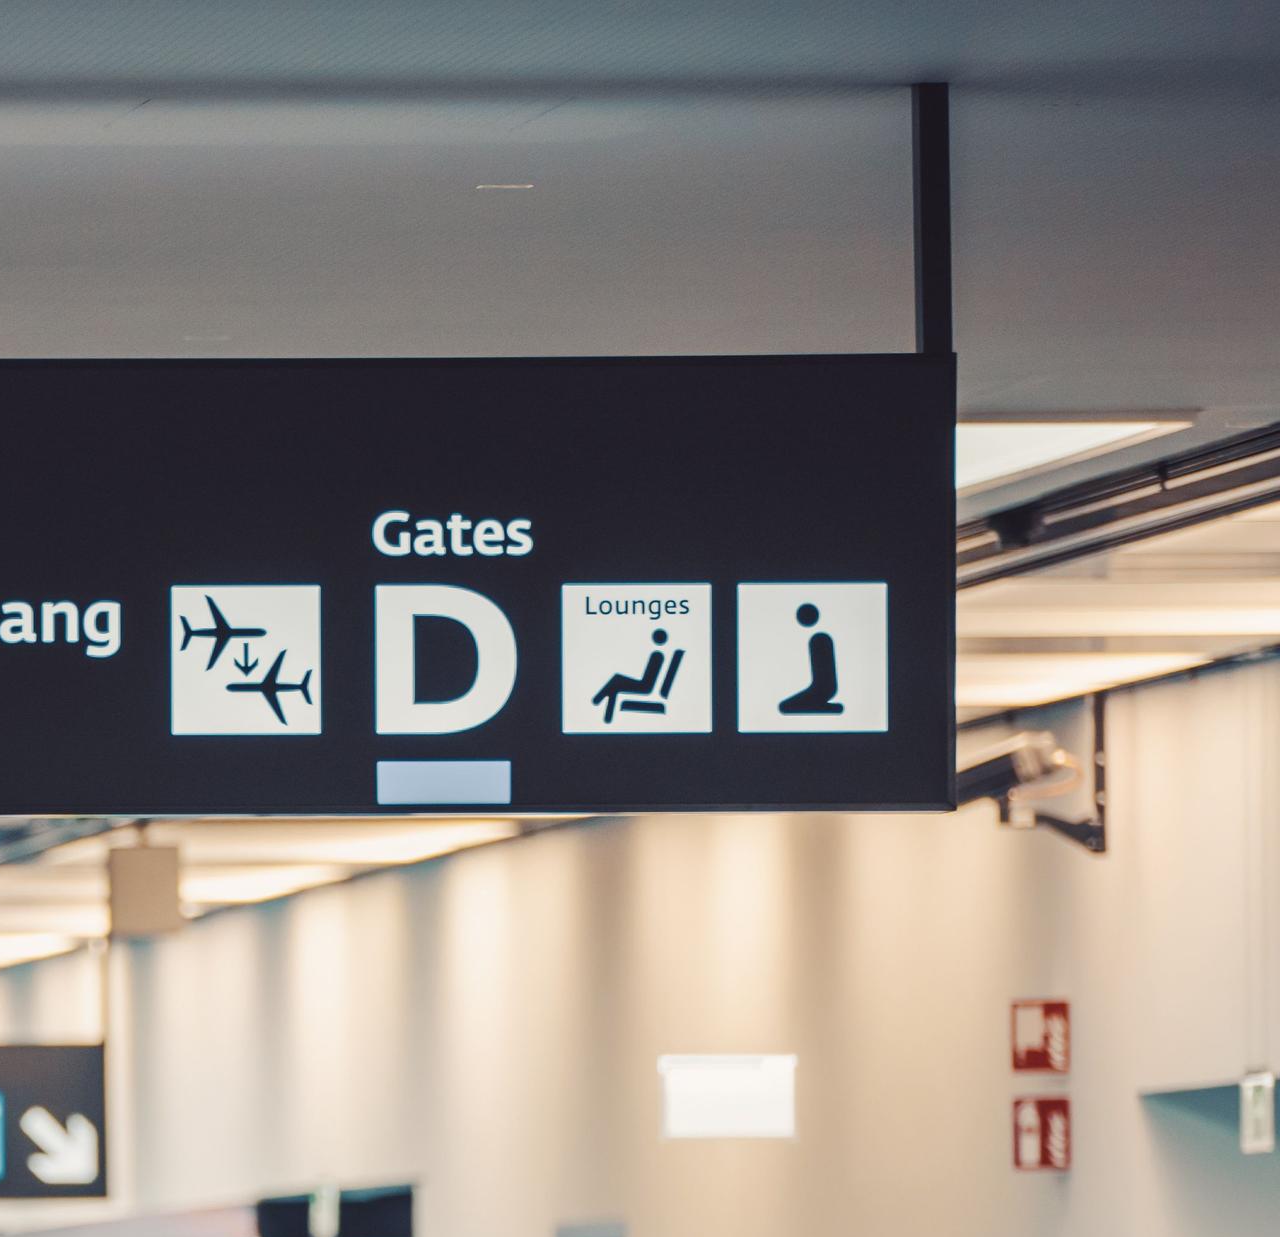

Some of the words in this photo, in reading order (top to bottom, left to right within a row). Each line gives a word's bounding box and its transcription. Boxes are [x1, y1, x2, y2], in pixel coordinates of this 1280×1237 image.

[373, 511, 535, 556] Gates
[585, 596, 691, 621] Lounges
[375, 583, 518, 735] D
